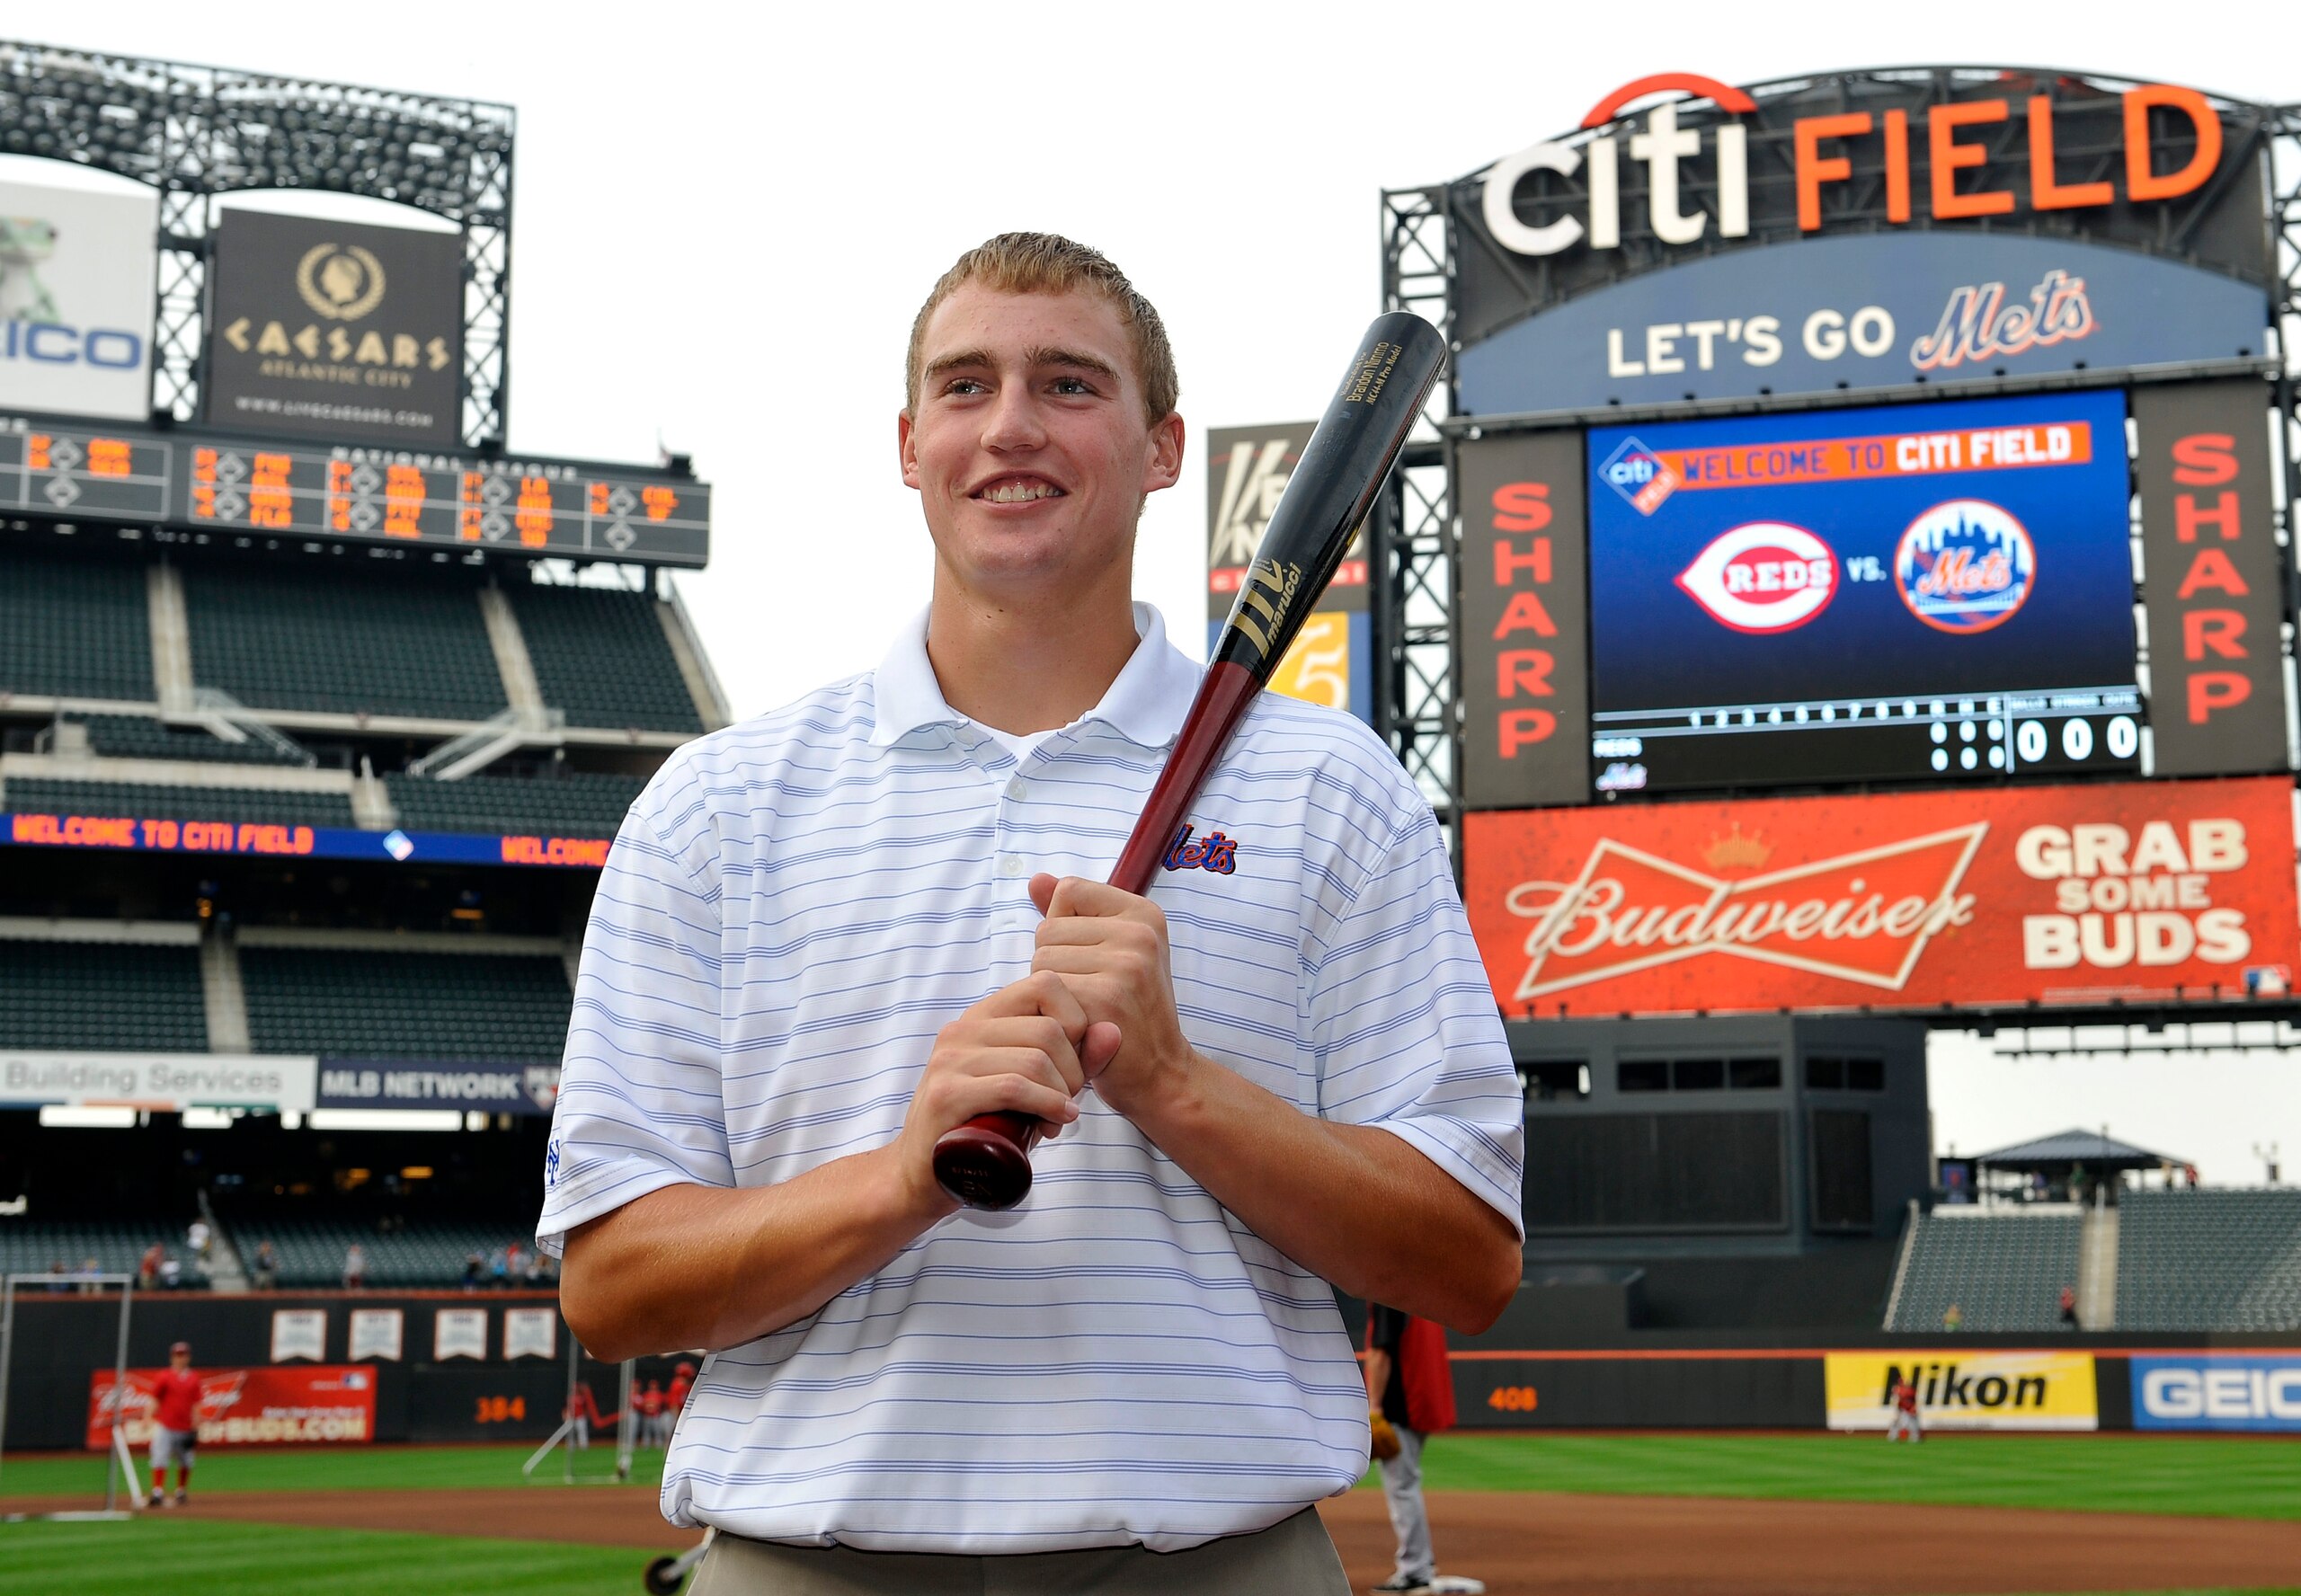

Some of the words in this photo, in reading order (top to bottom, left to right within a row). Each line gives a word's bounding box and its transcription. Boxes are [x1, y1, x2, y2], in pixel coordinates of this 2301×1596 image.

[1482, 102, 1750, 256] citi
[1794, 84, 2223, 231] FIELD
[0, 321, 141, 370] ICO
[225, 317, 449, 371] CAESARS
[1608, 315, 1783, 377] LET'S
[1803, 306, 1897, 360] GO
[1911, 270, 2101, 369] Mets
[260, 359, 360, 386] ATLANTIC
[364, 368, 413, 389] CITY
[1346, 369, 1376, 402] Brandon
[1364, 341, 1390, 368] Nimmo
[1379, 366, 1391, 379] Pro
[1386, 344, 1402, 367] Model
[1684, 446, 1828, 483] WELCOME
[1847, 442, 1885, 471] TO
[1897, 435, 1959, 471] CITI
[1970, 426, 2072, 466] FIELD
[1723, 558, 1832, 594] REDS
[1916, 546, 2012, 596] Mets
[2172, 433, 2252, 725] SHARP
[1267, 561, 1302, 646] marucci
[1492, 481, 1558, 759] SHARP
[2017, 720, 2048, 762] 0
[2062, 717, 2093, 760] 0
[2107, 715, 2138, 758] 0
[13, 814, 136, 848] WELCOME
[141, 818, 178, 849] TO
[182, 820, 234, 852] CITI
[238, 822, 314, 855] FIELD
[502, 835, 611, 866] WELCOME
[2015, 818, 2248, 881] GRAB
[2057, 873, 2211, 912] SOME
[1506, 877, 1976, 959] Budweiser
[2024, 909, 2252, 971] BUDS
[5, 1060, 137, 1096] Building
[148, 1062, 282, 1093] Services
[321, 1069, 381, 1097] MLB
[384, 1070, 520, 1100] NETWORK
[475, 1396, 526, 1423] 384
[1488, 1386, 1538, 1412] 408
[1883, 1363, 2048, 1408] Nikon
